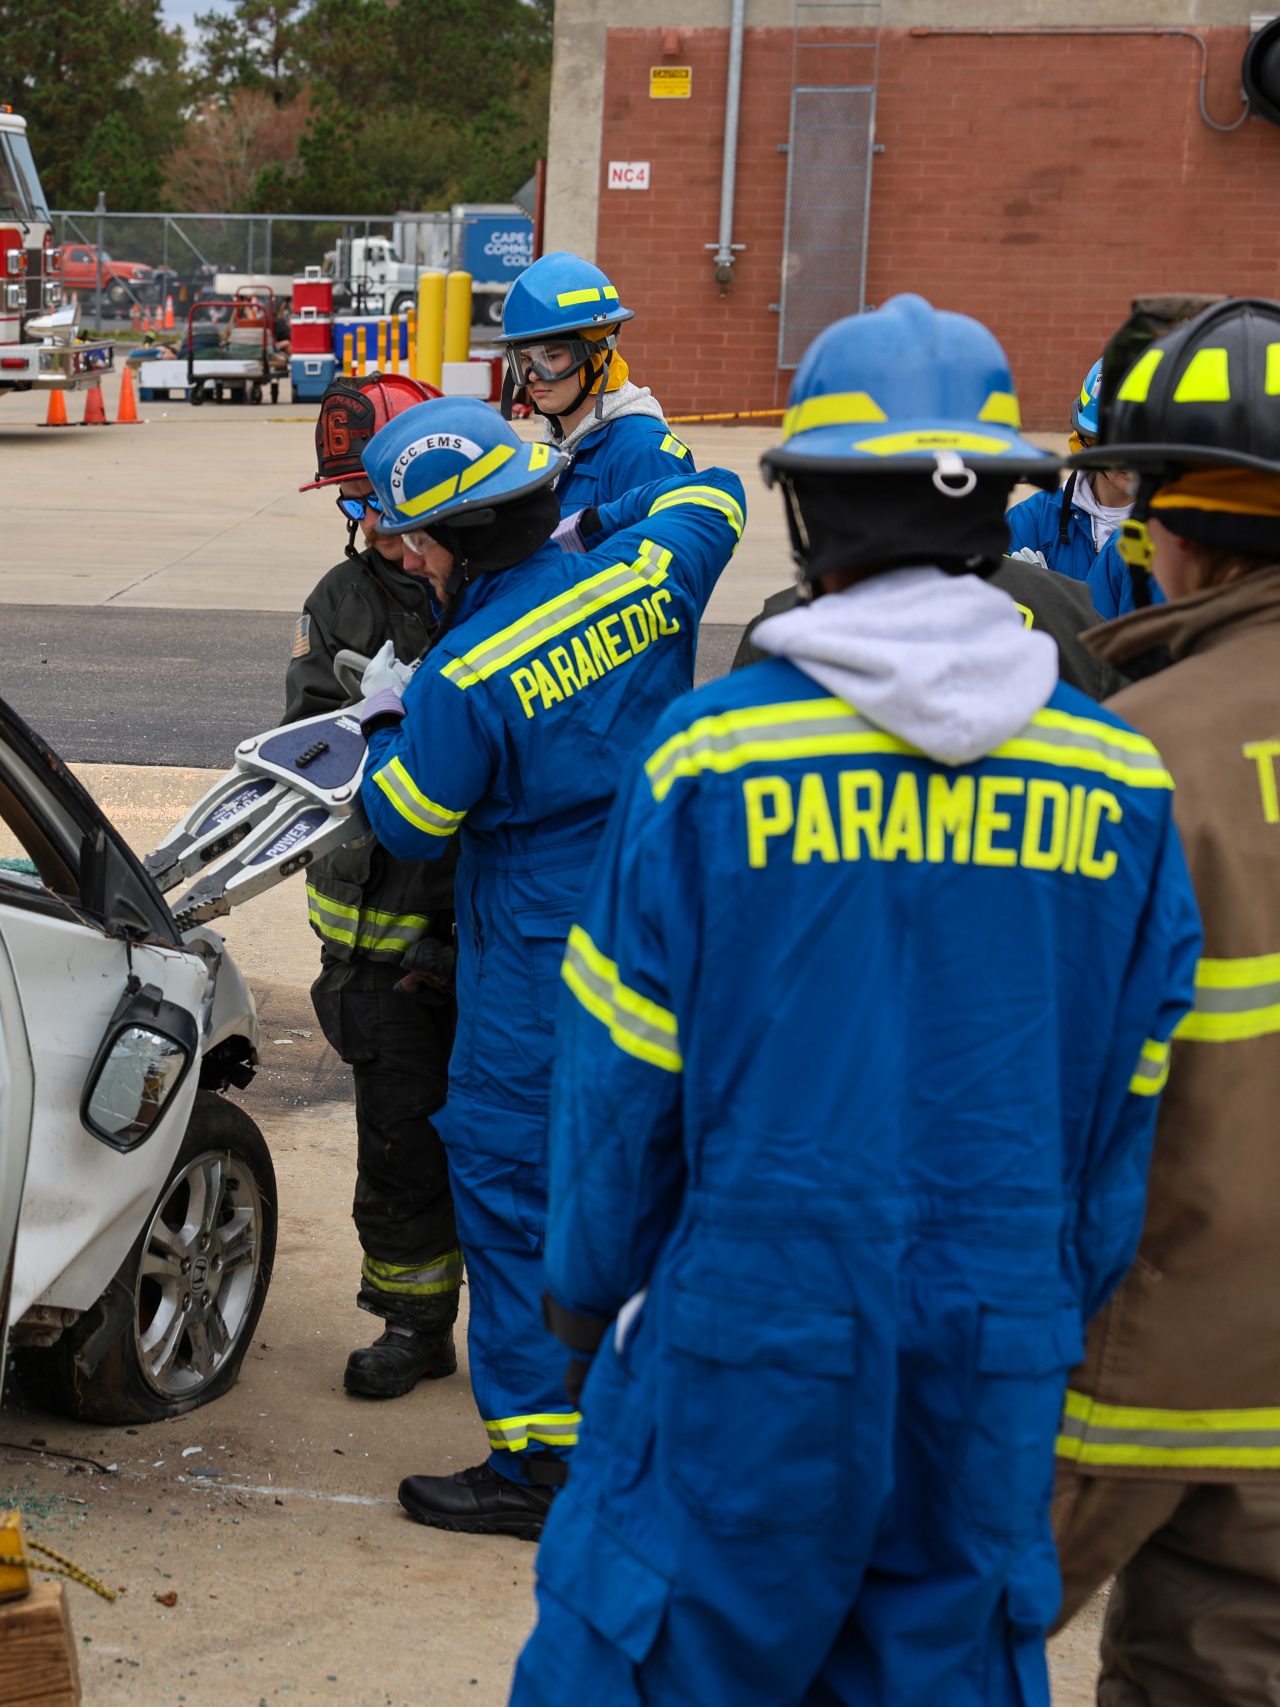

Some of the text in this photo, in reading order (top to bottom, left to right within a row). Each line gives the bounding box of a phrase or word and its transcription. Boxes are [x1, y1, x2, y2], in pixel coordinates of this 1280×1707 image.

[491, 232, 526, 243] CAPE
[392, 437, 462, 488] CFCC EMS
[510, 588, 680, 719] PARAMEDIC
[265, 822, 310, 859] POWER
[743, 770, 1122, 880] PARAMEDIC
